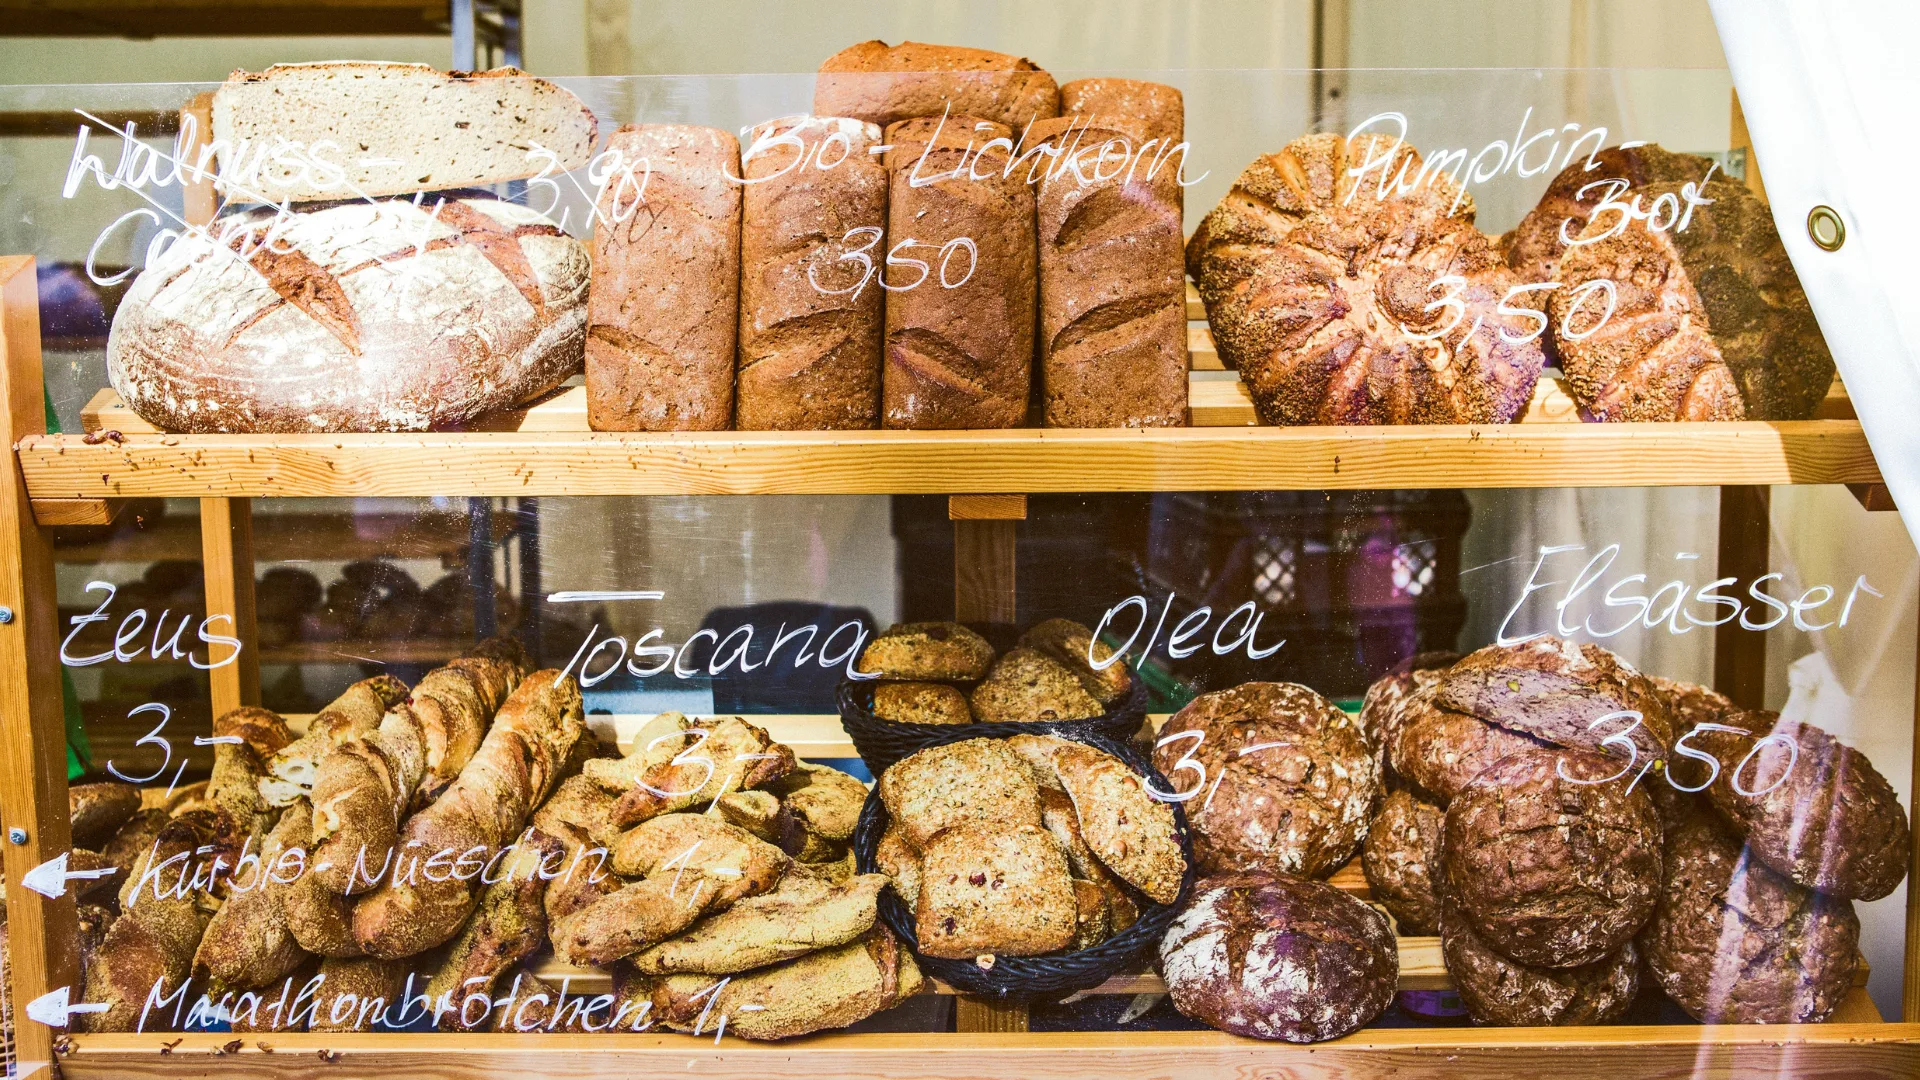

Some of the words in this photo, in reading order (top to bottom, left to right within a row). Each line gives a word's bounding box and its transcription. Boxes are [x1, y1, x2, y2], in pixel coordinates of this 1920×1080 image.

[1342, 106, 1652, 218] Pumpkin-
[1558, 161, 1721, 247] Brot
[807, 226, 979, 303] 3,50
[1400, 274, 1618, 353] 3,50
[60, 580, 244, 670] Zeus
[1088, 592, 1287, 671] Olea
[1496, 543, 1886, 648] Elsässer
[546, 590, 883, 689] Toscana
[1556, 709, 1799, 798] 3,50
[137, 972, 662, 1035] Marathonbrötchen
